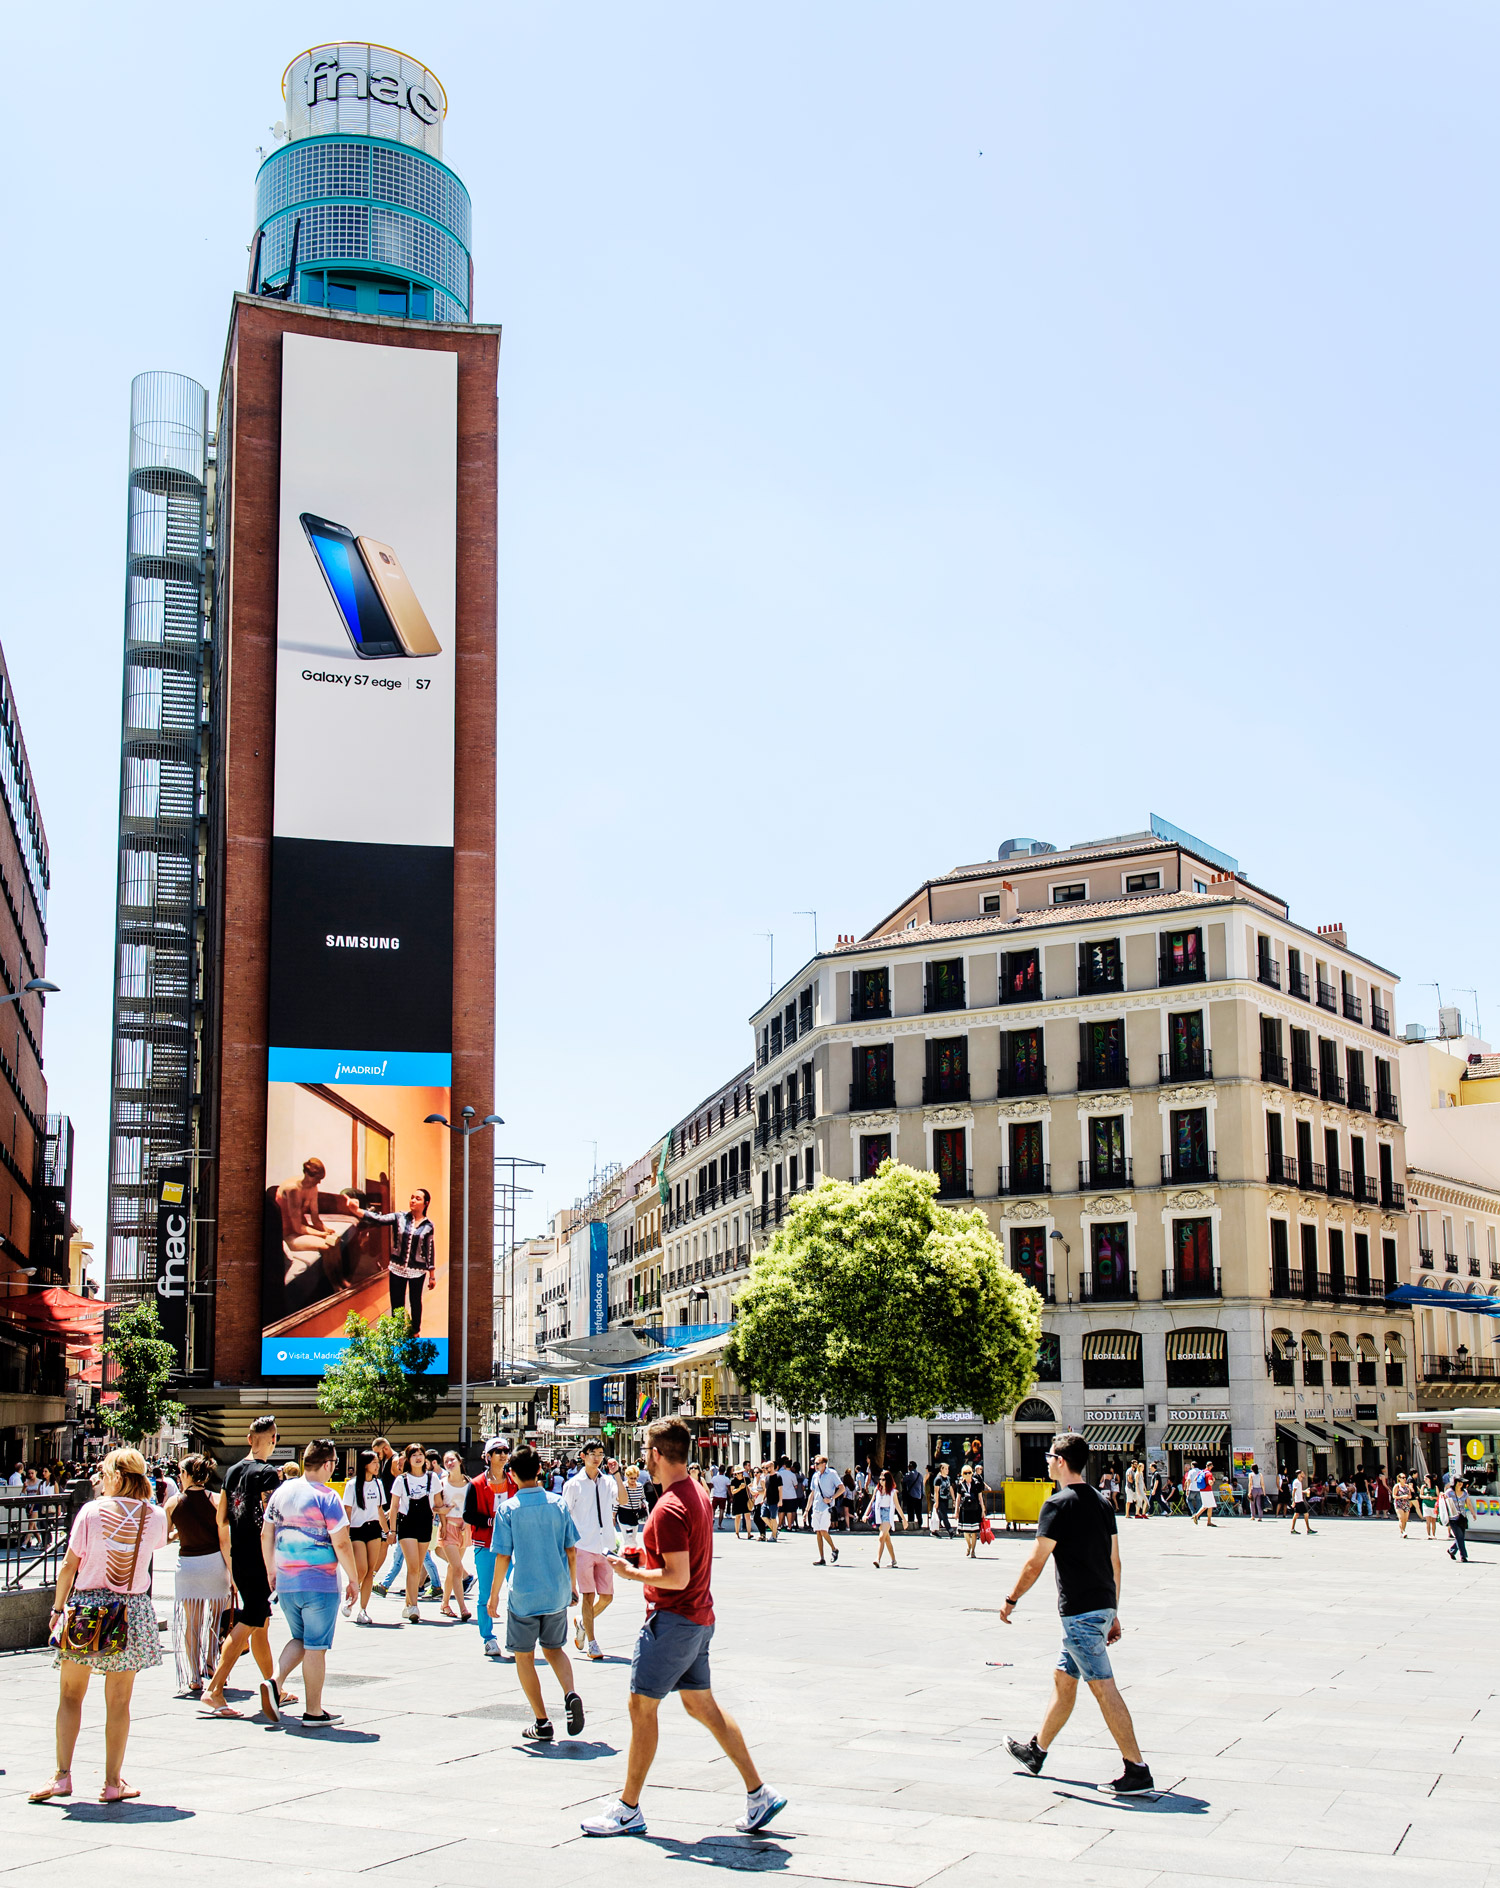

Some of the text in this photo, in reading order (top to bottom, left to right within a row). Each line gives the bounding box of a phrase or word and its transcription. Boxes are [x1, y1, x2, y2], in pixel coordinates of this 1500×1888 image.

[304, 55, 438, 125] fnac
[301, 669, 431, 691] Galaxy S7 edge S7
[325, 934, 400, 950] SAMSUNG
[334, 1060, 388, 1080] ¡MADRID!
[163, 1185, 183, 1193] fnac
[157, 1214, 186, 1298] fnac
[593, 1273, 605, 1335] refugiados.org
[1177, 1352, 1212, 1360] RODILLA
[702, 1400, 714, 1409] ORO
[1086, 1411, 1142, 1421] RODILLA
[1170, 1410, 1228, 1420] RODILLA
[1173, 1443, 1208, 1451] RODILLA
[1464, 1463, 1488, 1475] ¡MADRID!
